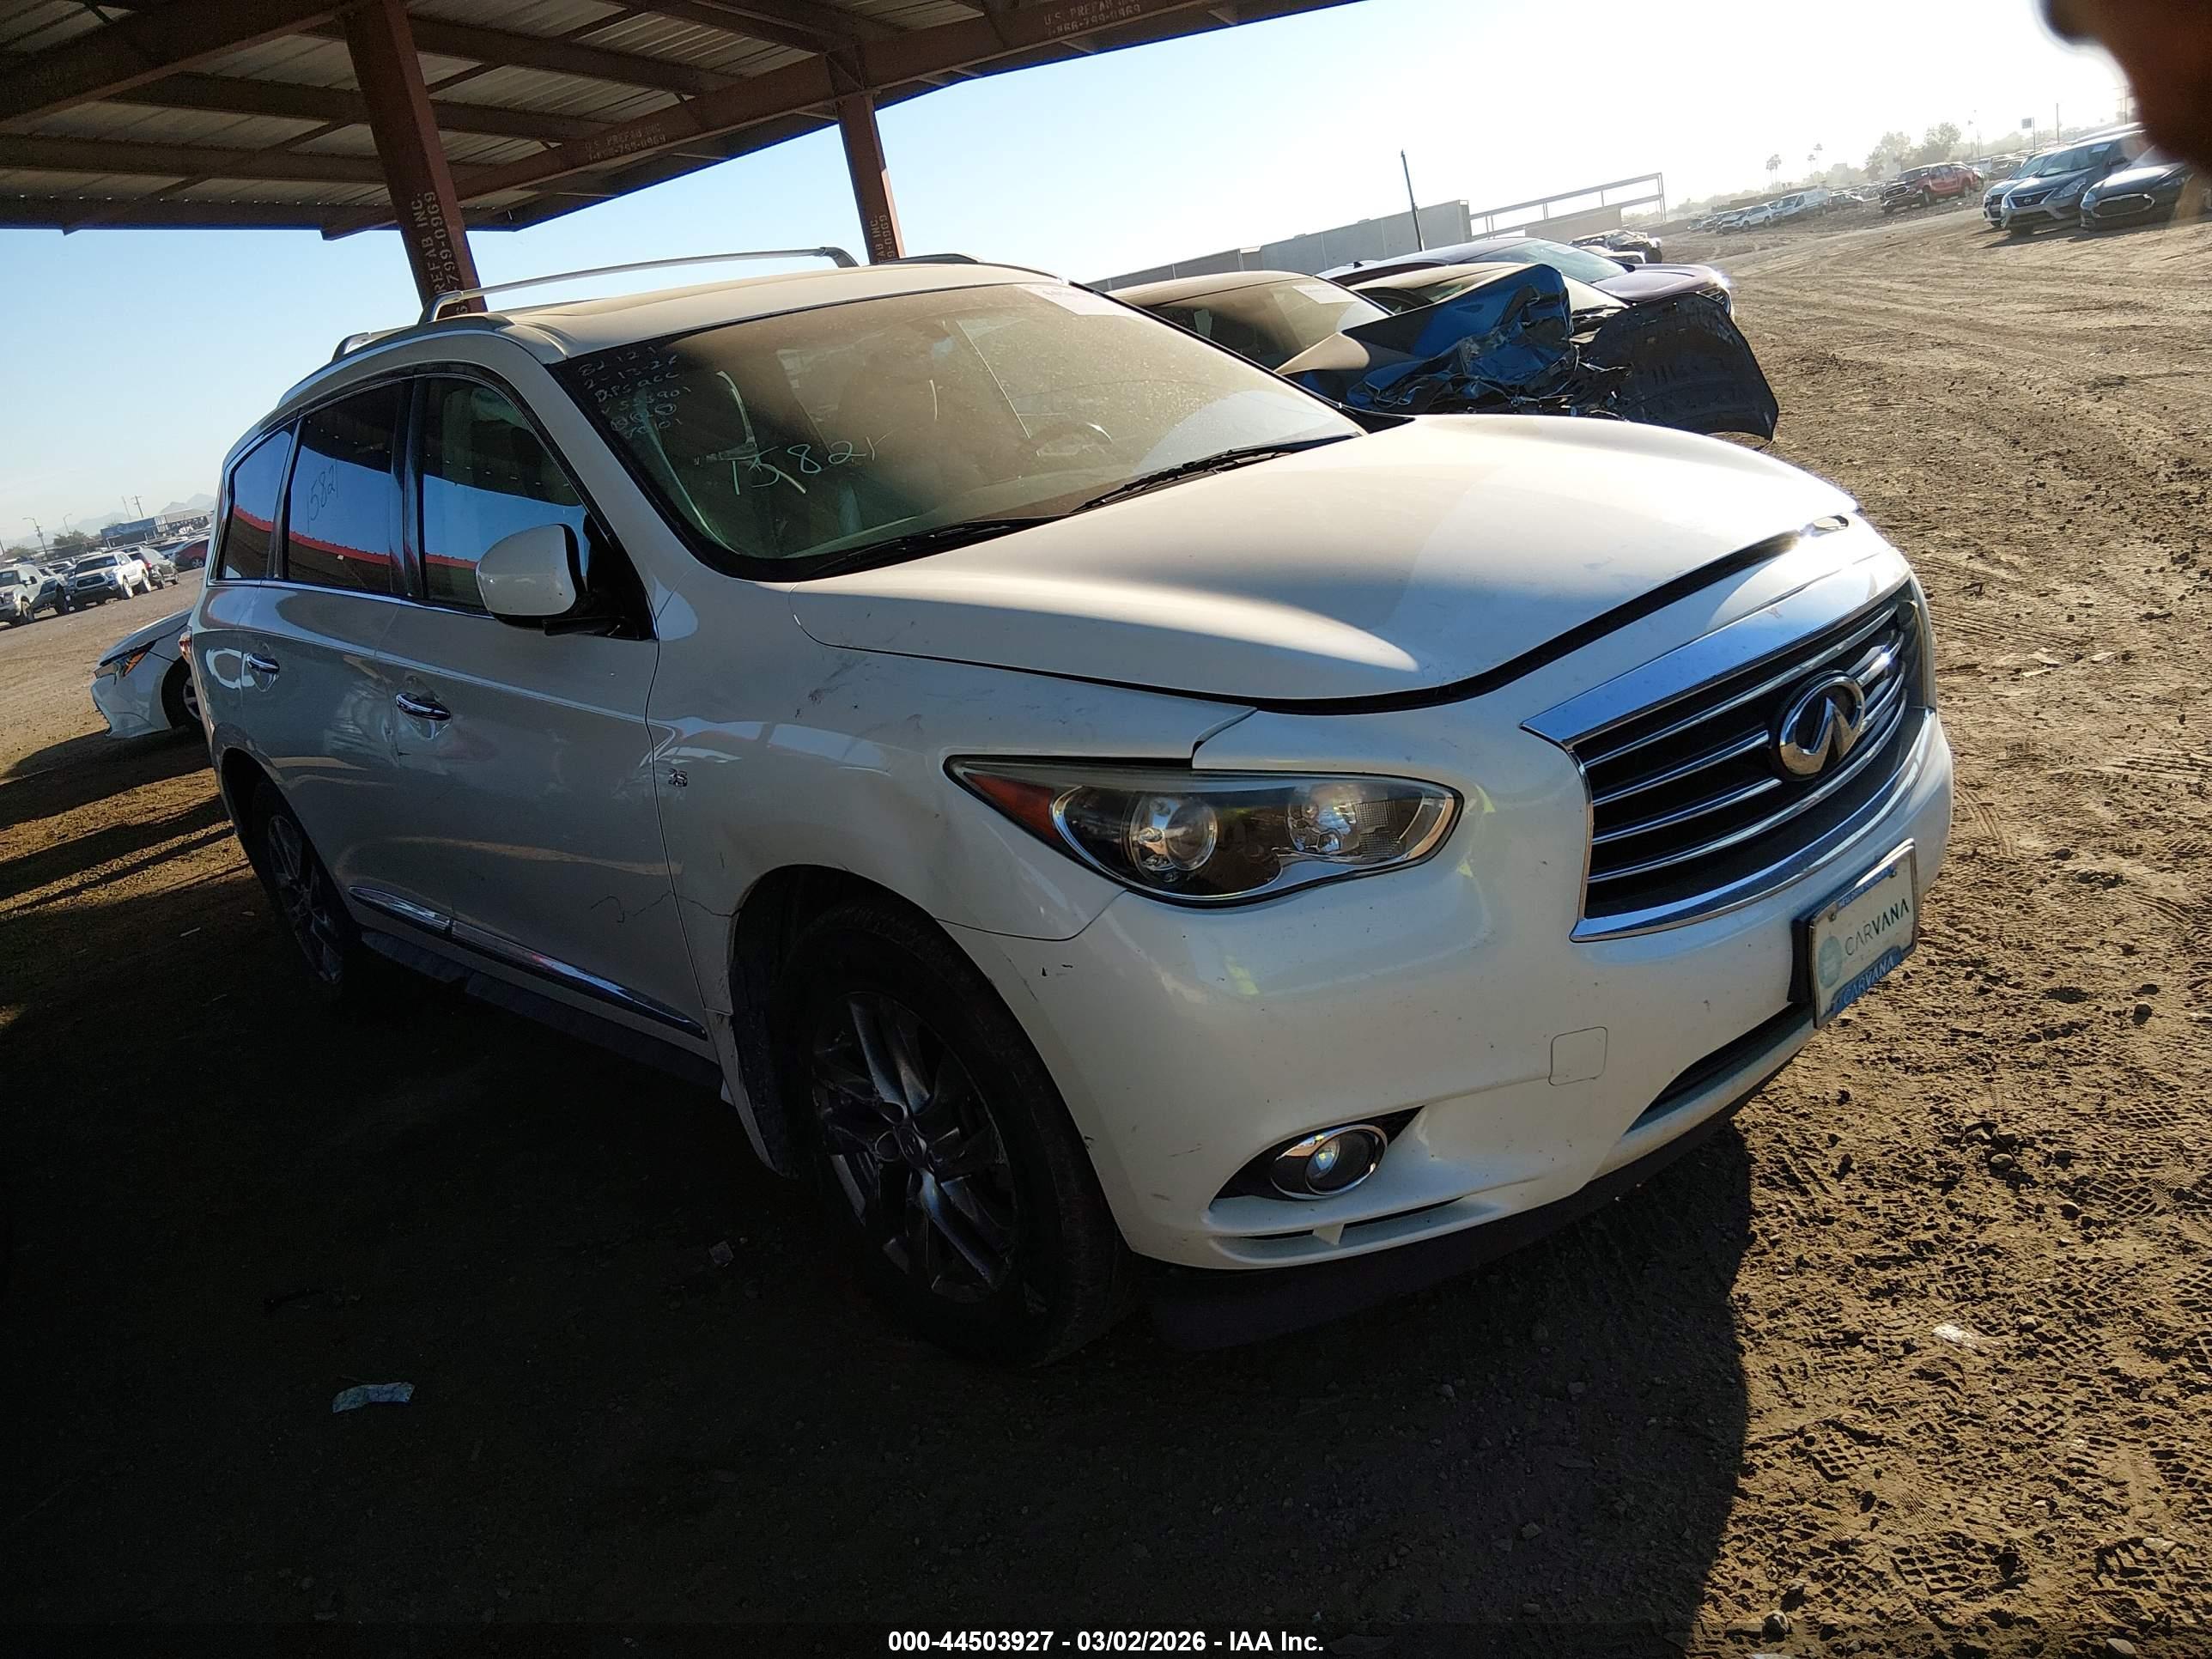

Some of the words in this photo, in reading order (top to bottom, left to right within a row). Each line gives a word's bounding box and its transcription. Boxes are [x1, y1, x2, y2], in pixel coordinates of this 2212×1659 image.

[411, 193, 428, 228] INC.
[422, 236, 447, 293] REFAB
[1844, 898, 1910, 956] CARVANA
[1842, 956, 1893, 1004] CARVANA
